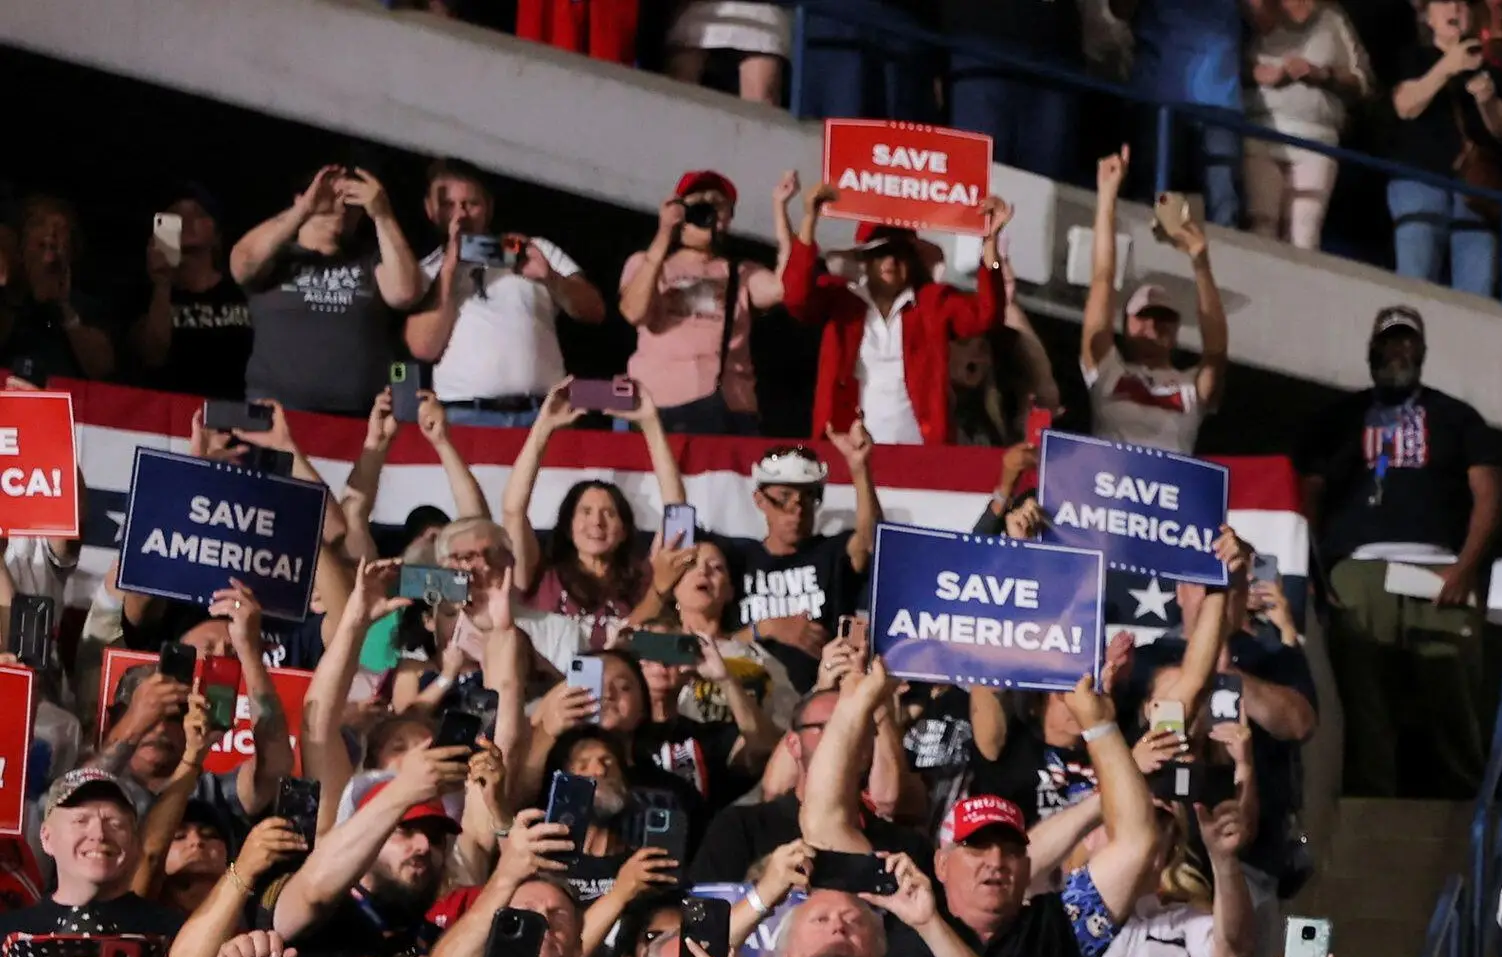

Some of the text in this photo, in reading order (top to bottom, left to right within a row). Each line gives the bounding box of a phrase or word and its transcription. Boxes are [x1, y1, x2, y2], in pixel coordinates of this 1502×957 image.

[872, 143, 948, 174] SAVE
[838, 167, 979, 206] AMERICA!
[1094, 471, 1180, 511] SAVE
[189, 495, 276, 537] SAVE
[1053, 501, 1213, 553] AMERICA!
[141, 527, 303, 584] AMERICA!
[755, 565, 819, 597] LOVE
[935, 570, 1040, 609] SAVE
[739, 590, 826, 624] TRUMP
[887, 608, 1083, 654] AMERICA!
